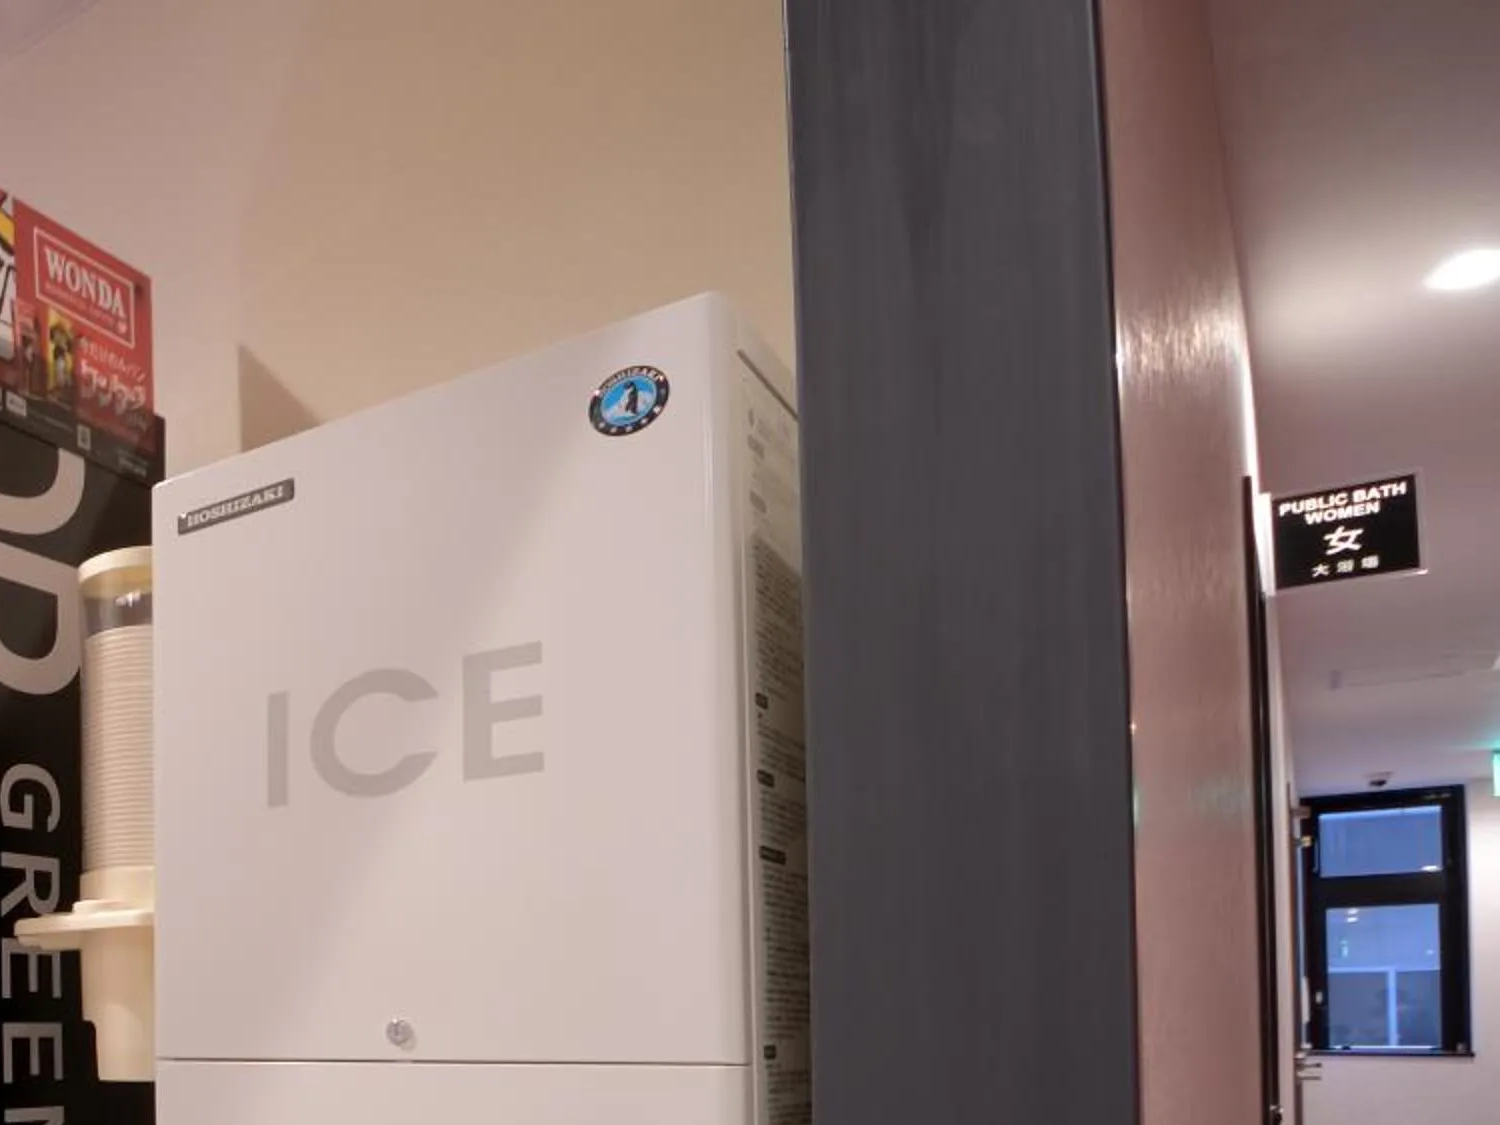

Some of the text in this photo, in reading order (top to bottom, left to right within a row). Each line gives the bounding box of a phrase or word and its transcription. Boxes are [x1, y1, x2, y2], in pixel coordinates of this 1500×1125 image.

[44, 246, 127, 319] WONDA
[187, 485, 283, 527] HOSHIZAKI
[1279, 481, 1407, 517] PUBLIC BATH
[1305, 501, 1381, 525] WOMEN
[1323, 525, 1365, 555] 女
[267, 640, 545, 809] ICE
